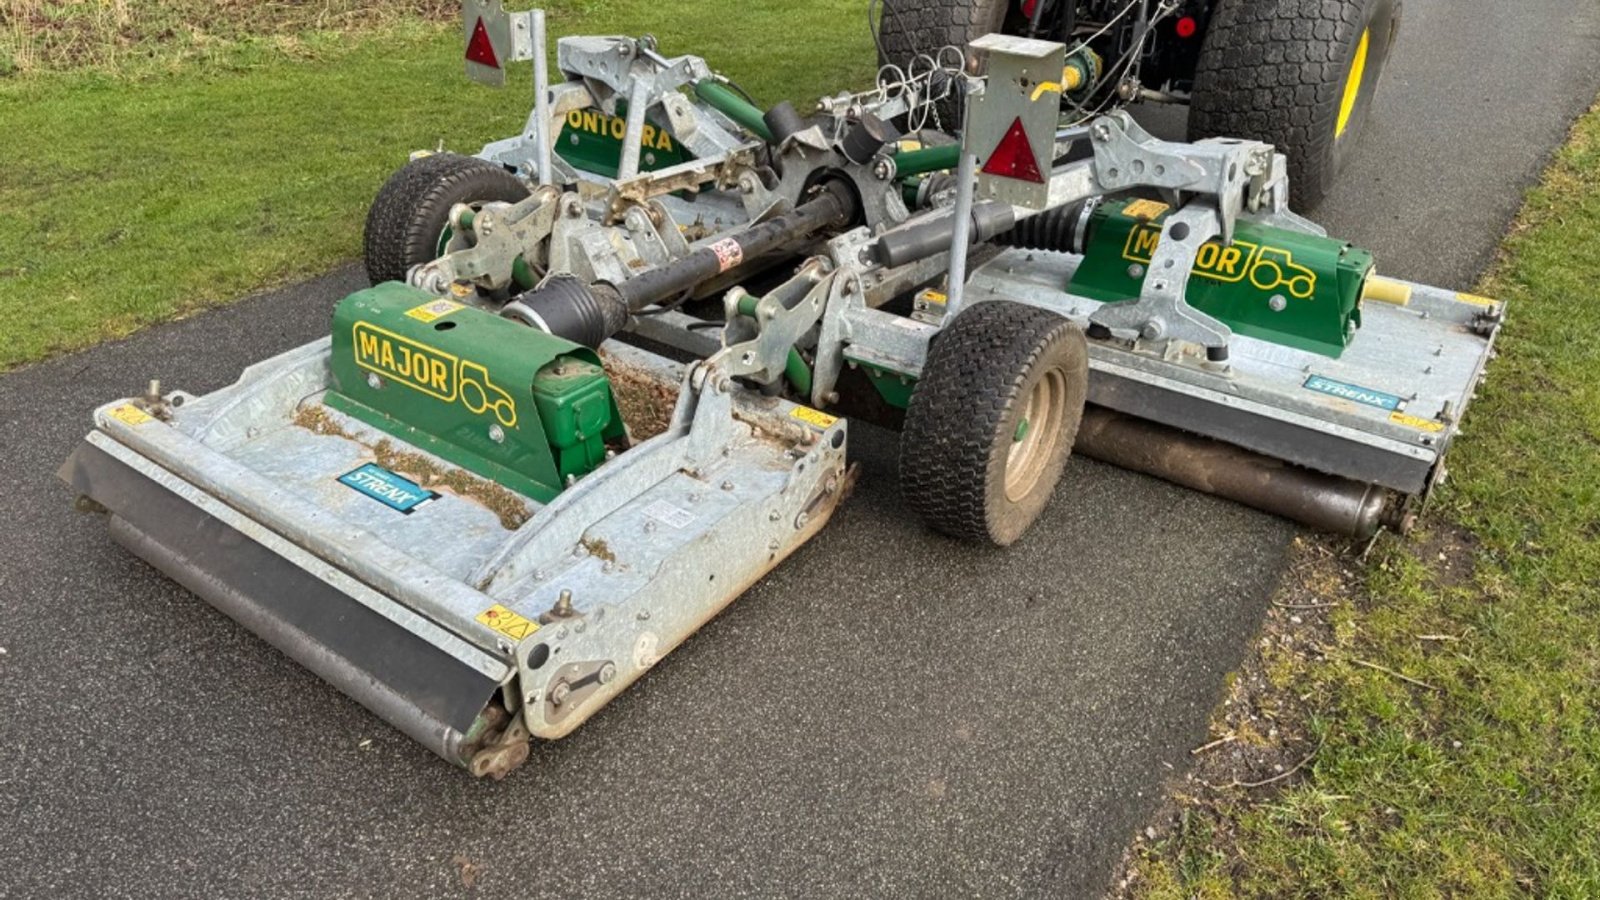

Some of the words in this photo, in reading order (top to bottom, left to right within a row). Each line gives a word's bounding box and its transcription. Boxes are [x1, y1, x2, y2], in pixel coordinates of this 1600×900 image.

[565, 109, 673, 152] ONTORA
[1134, 229, 1241, 274] MOR
[359, 331, 448, 393] MAJOR
[1310, 380, 1384, 406] STRENX
[347, 470, 419, 504] STRENX
